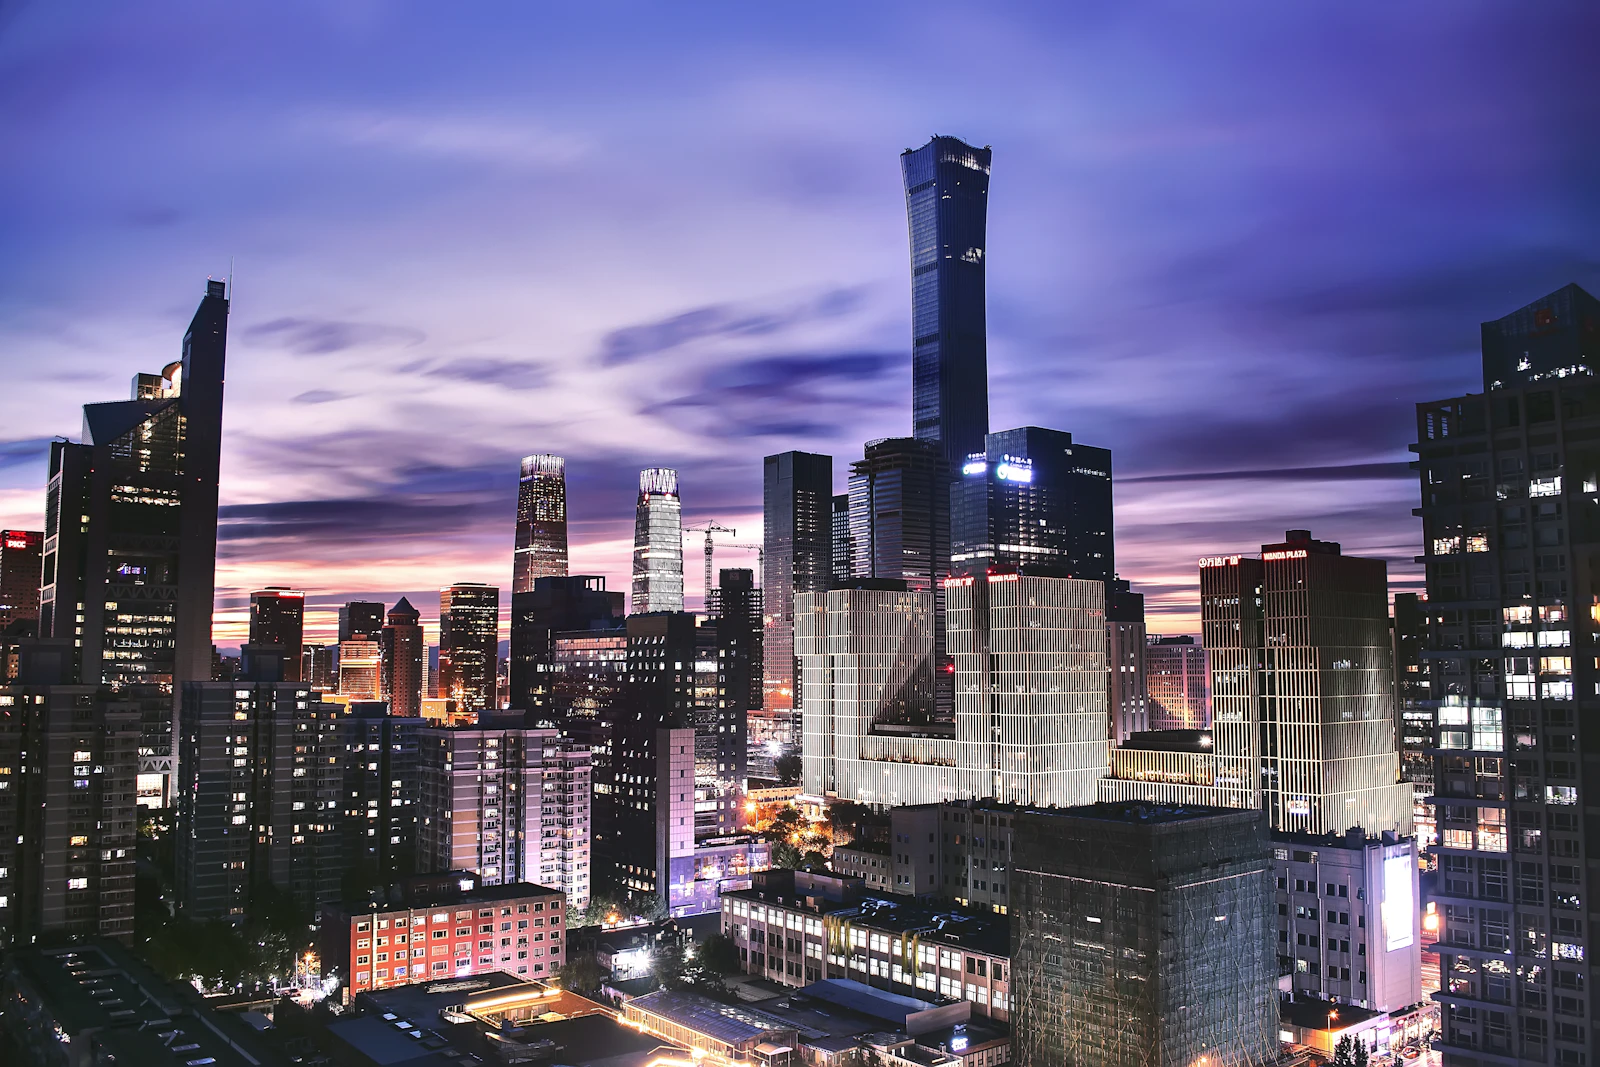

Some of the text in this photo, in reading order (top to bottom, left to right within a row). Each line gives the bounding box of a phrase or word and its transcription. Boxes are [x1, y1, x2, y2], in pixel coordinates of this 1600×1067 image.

[8, 540, 26, 548] PICC
[1263, 550, 1307, 560] WANDA PLAZA
